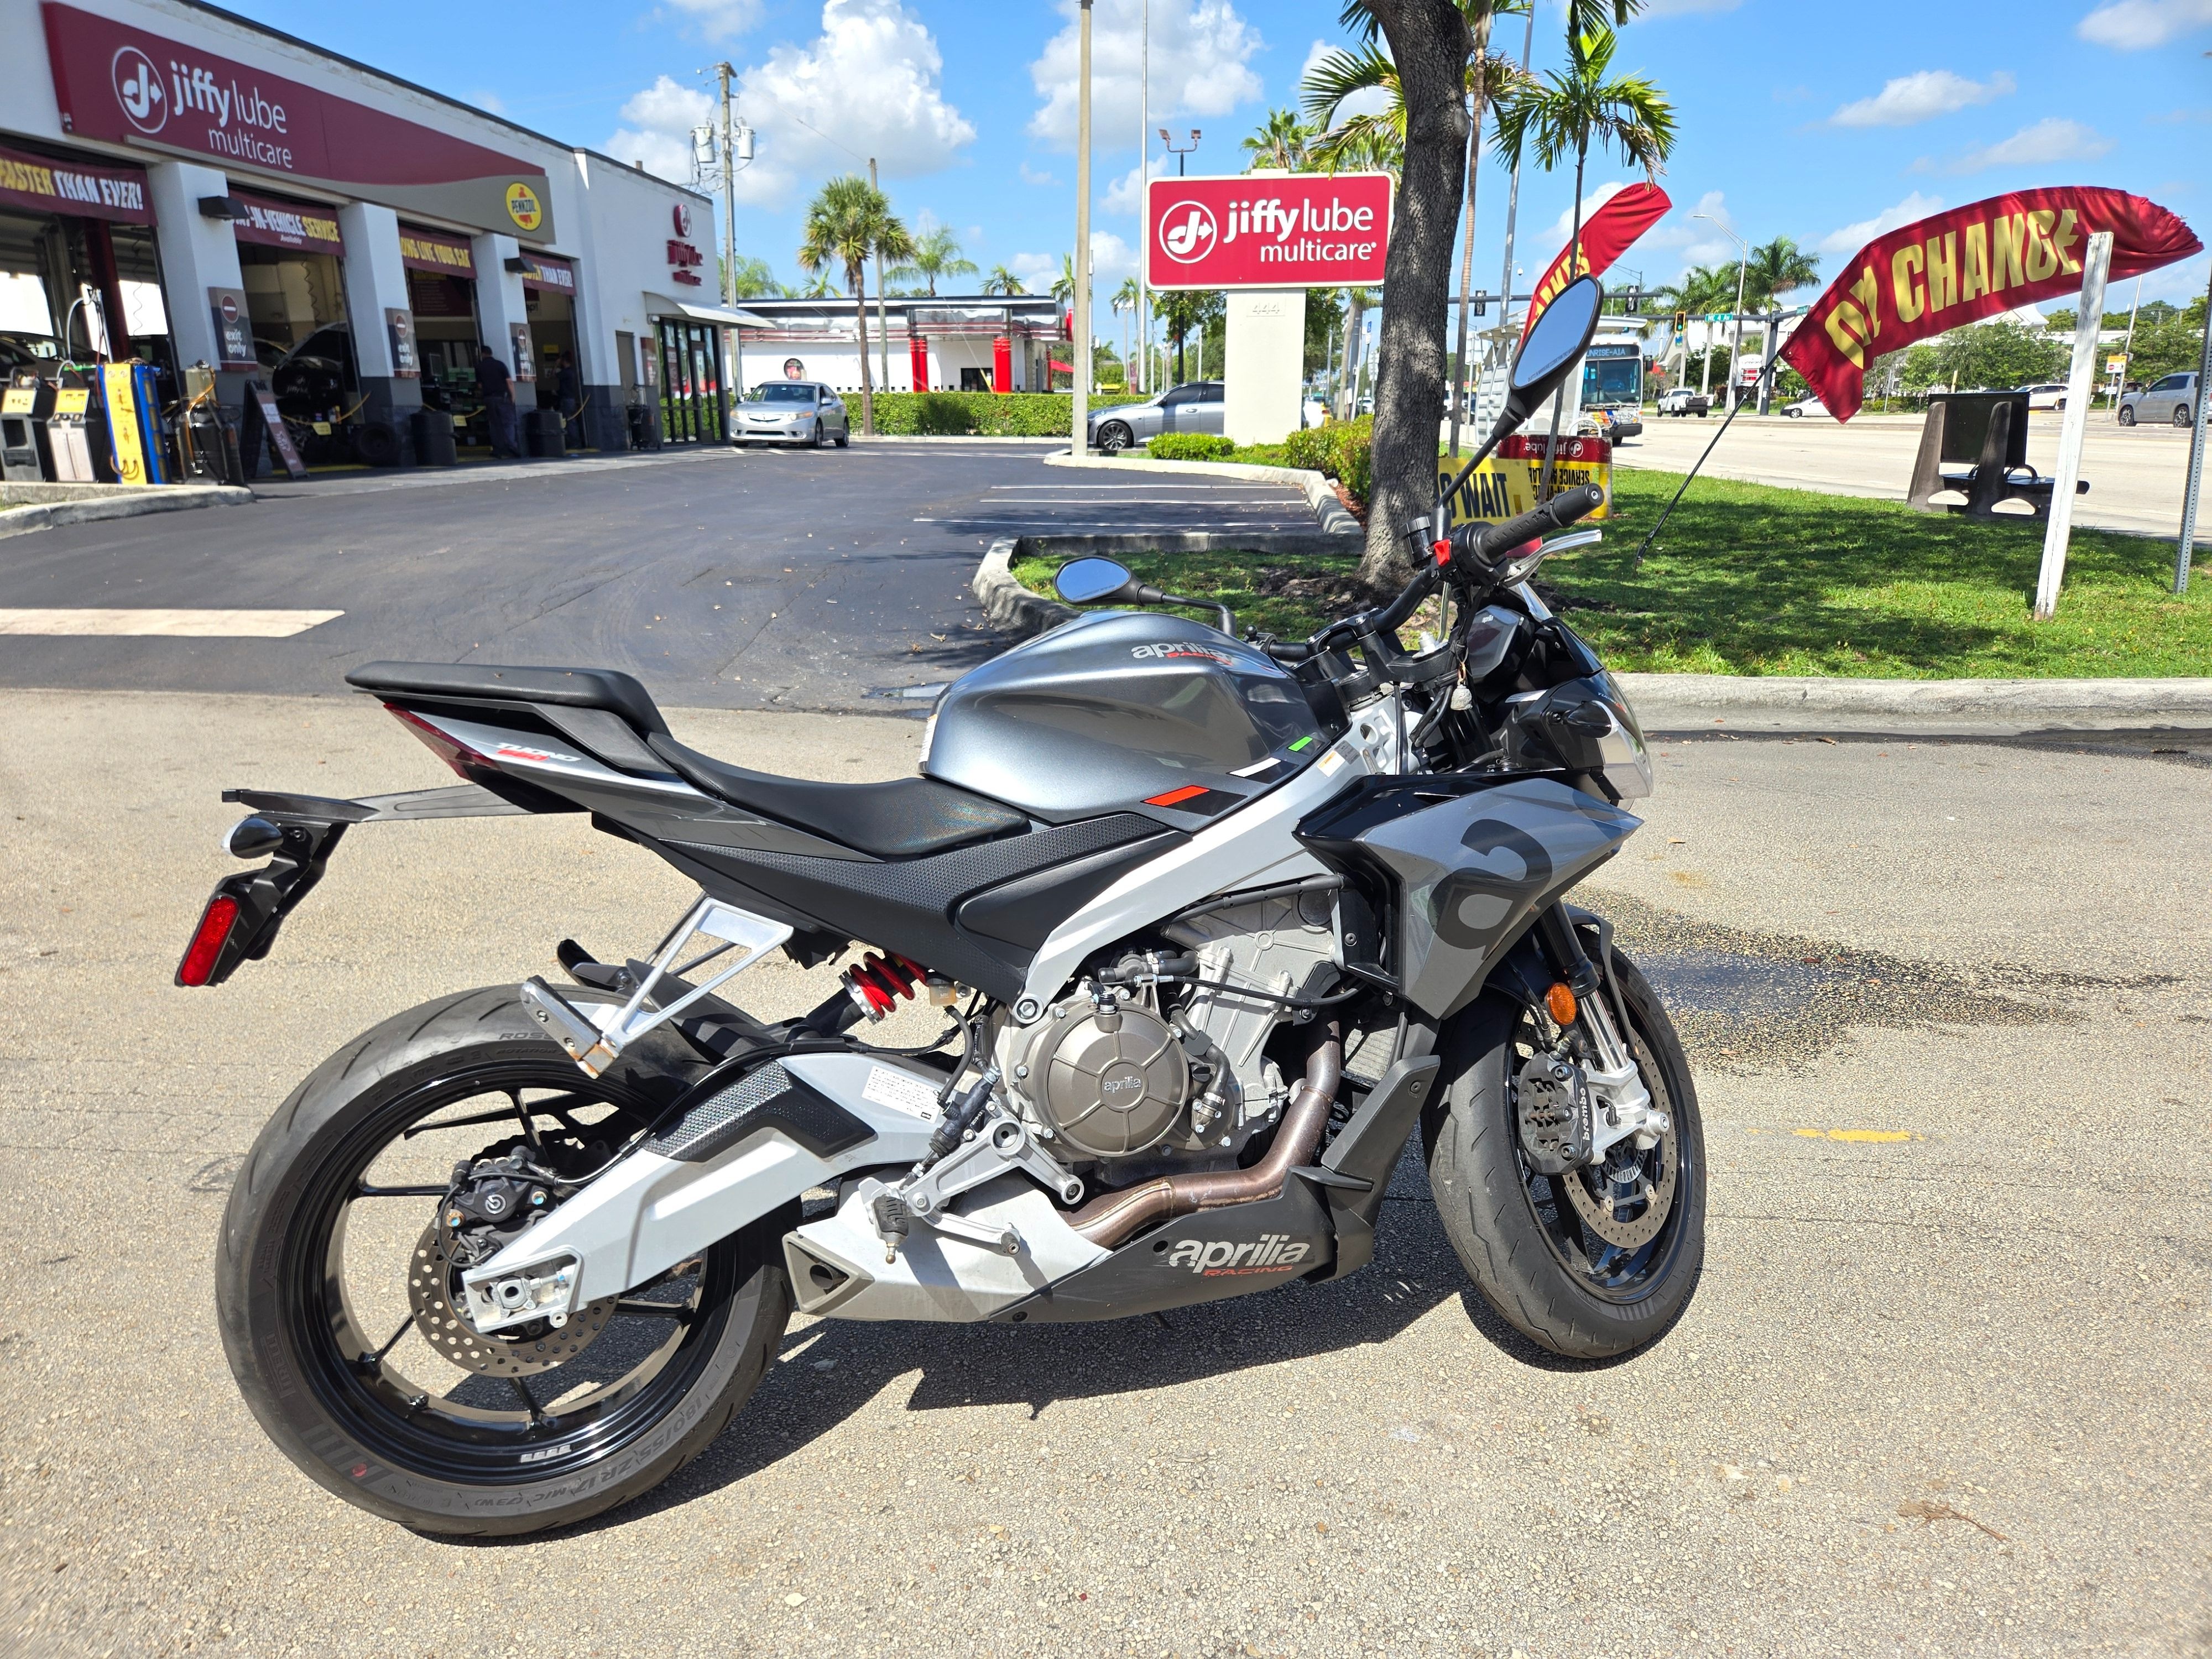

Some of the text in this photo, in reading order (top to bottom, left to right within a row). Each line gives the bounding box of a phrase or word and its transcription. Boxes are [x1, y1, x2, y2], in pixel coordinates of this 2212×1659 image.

[171, 60, 287, 133] jiffy lube
[208, 128, 293, 168] multicare
[54, 169, 101, 204] THAN
[99, 177, 143, 210] EVER!
[511, 199, 536, 213] PENNZOIL
[301, 216, 340, 243] SERVICE
[1223, 197, 1374, 243] jiffy lube
[1260, 238, 1373, 262] multicare
[1892, 209, 2083, 322] CHANGE
[226, 328, 242, 342] exit
[228, 341, 246, 357] only
[398, 343, 410, 354] exit
[399, 353, 413, 366] only
[1587, 347, 1626, 357] UNRISE-A1A
[1559, 469, 1590, 486] SERVICE
[1457, 473, 1511, 519] WAIT
[1131, 641, 1232, 659] aprilia
[1104, 1076, 1142, 1093] aprilia
[1578, 1087, 1591, 1141] brembo
[1168, 1234, 1311, 1274] aprilia
[1203, 1265, 1293, 1277] RACING
[640, 1396, 702, 1459] 180/55
